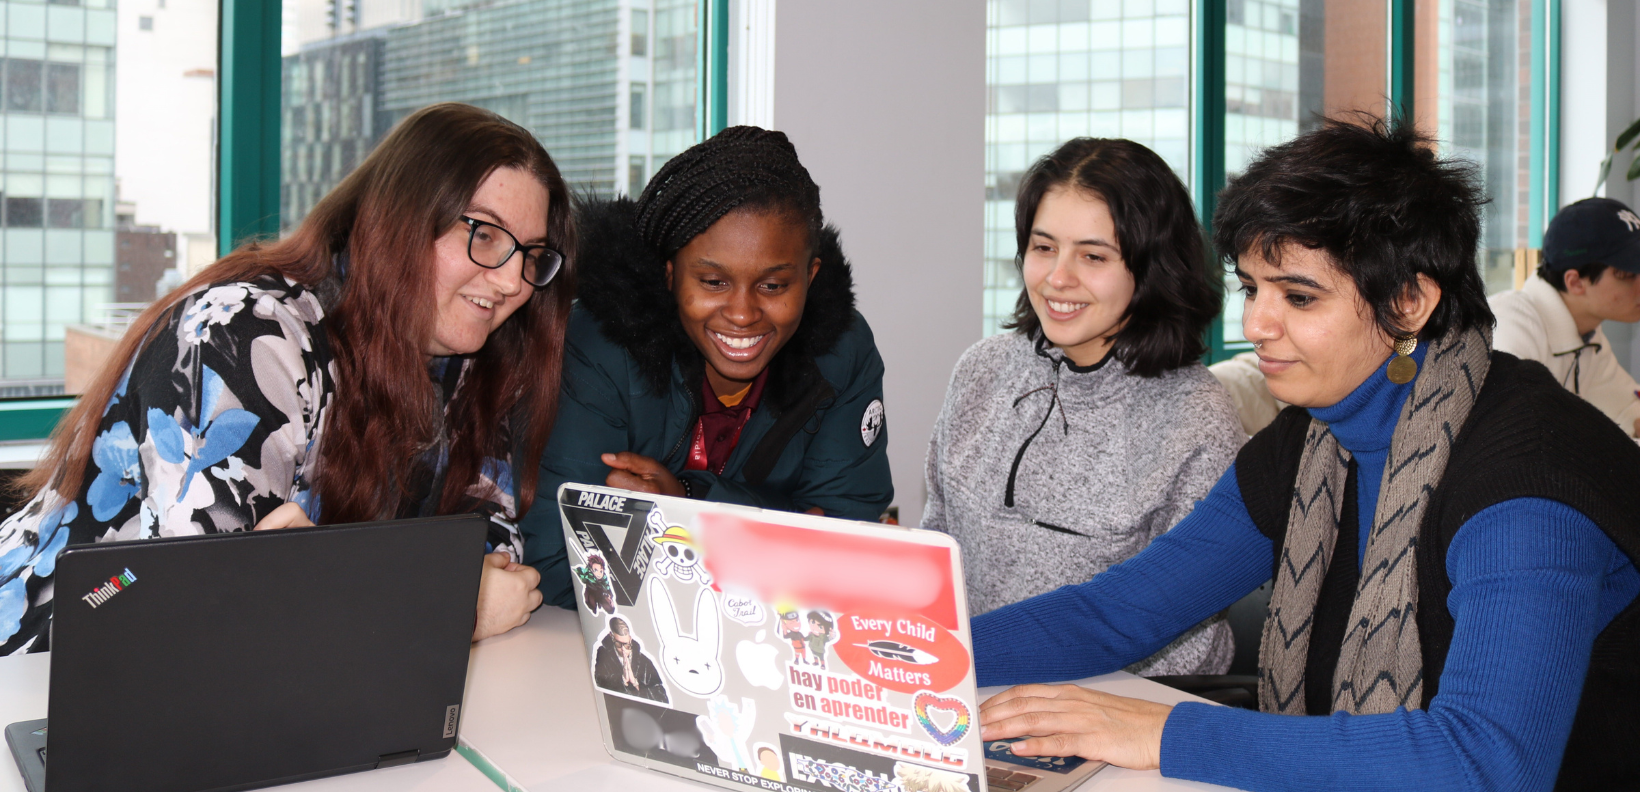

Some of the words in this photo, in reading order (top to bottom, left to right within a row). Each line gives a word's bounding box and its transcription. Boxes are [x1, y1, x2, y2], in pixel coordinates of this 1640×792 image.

[578, 492, 627, 512] PALACE
[82, 567, 137, 608] ThinkPad
[733, 605, 756, 617] Trail
[851, 616, 892, 637] Every
[897, 619, 936, 642] Child
[789, 666, 822, 691] hay
[827, 676, 884, 701] poder
[868, 660, 931, 686] Matters
[445, 707, 456, 735] Lenovo
[793, 692, 817, 711] en
[821, 698, 909, 729] aprender
[696, 763, 730, 779] NEVER
[732, 773, 758, 786] STOP
